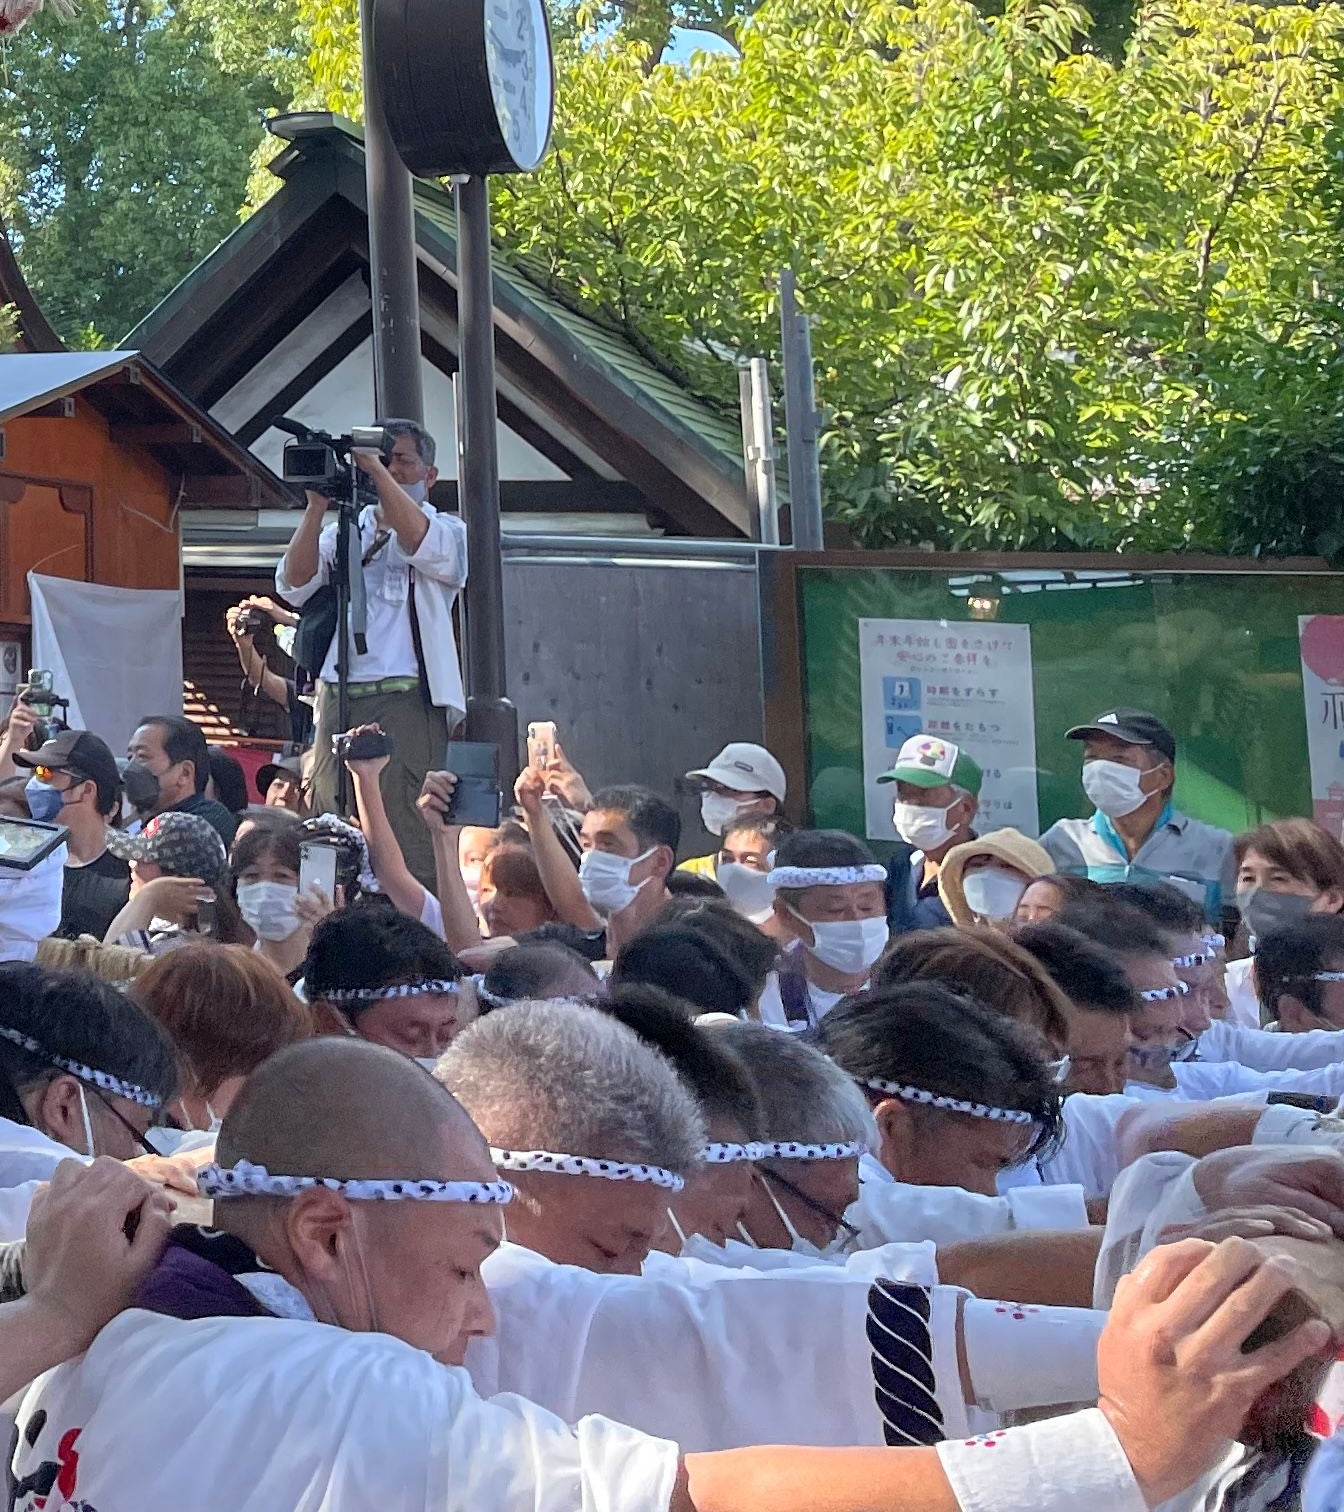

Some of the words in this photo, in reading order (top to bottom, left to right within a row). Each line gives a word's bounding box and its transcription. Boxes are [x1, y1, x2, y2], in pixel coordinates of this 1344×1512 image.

[515, 8, 527, 41] 2
[520, 49, 529, 81] 3
[519, 86, 528, 117] 4
[512, 110, 521, 142] 5
